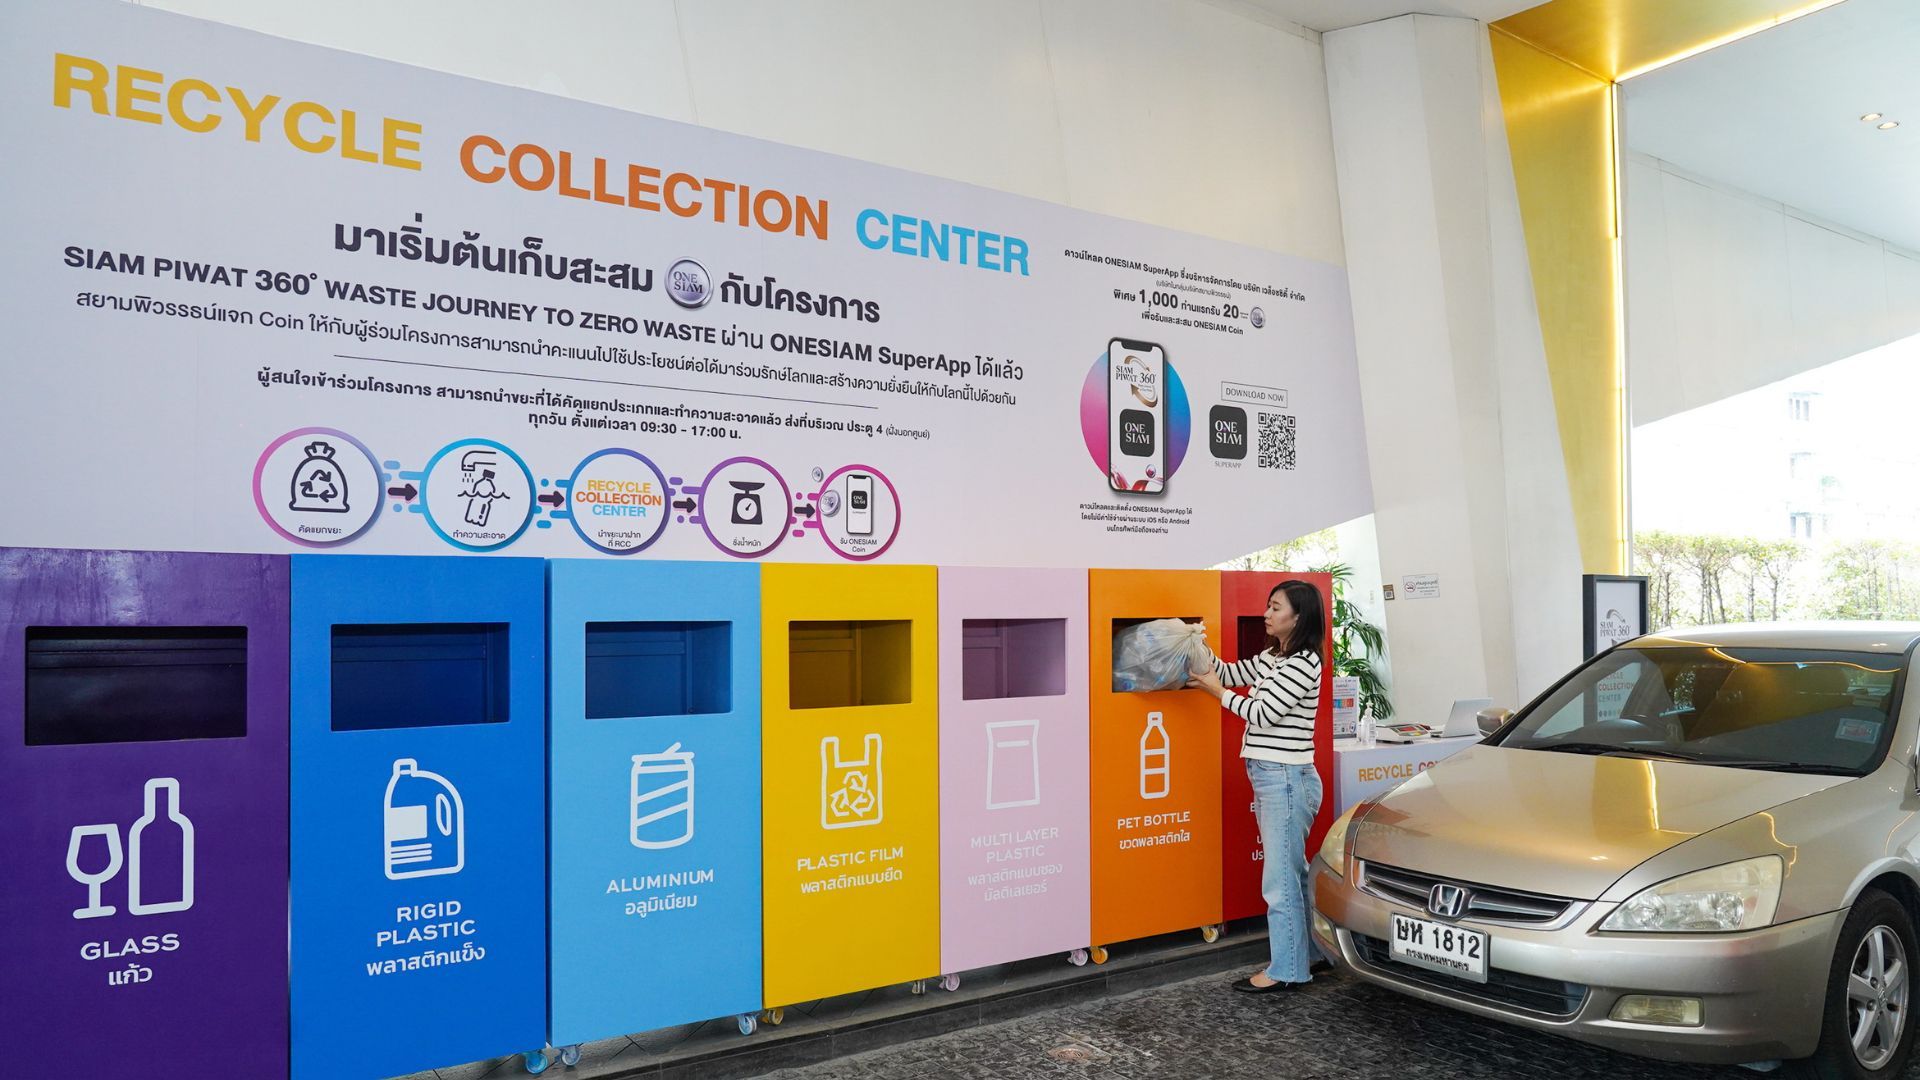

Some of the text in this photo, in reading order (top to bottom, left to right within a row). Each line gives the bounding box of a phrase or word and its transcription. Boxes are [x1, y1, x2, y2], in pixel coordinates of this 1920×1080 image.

[53, 53, 1030, 276] RECYCLE COLLECTION CENTER
[334, 212, 653, 293] มาเริ่มต้นเก็บสะสม
[673, 271, 697, 283] ONE
[1064, 249, 1103, 264] ดาวน์โหลด
[1104, 256, 1142, 270] ONESIAM
[1143, 263, 1179, 279] SuperApp
[1243, 282, 1261, 294] บริษัท
[674, 281, 703, 293] SIAM
[720, 272, 880, 323] กับโครงการ
[64, 246, 145, 275] SIAM
[154, 257, 248, 287] PIWAT
[324, 279, 417, 309] WASTE
[422, 293, 538, 322] JOURNEY
[543, 307, 574, 327] TO
[579, 312, 638, 334] ZERO
[643, 320, 716, 344] WASTE
[721, 323, 763, 349] ผ่าน
[770, 333, 872, 362] ONESIAM
[878, 346, 971, 377] SuperApp
[975, 355, 1024, 380] ได้แล้ว
[76, 291, 253, 324] สยามพิวรรธน์แจก
[259, 311, 304, 330] Coin
[1113, 288, 1136, 302] พิเศษ
[1139, 289, 1178, 309] 1,000
[1181, 300, 1220, 316] ท่านแรกรับ
[1223, 303, 1240, 319] 20
[1193, 320, 1227, 332] ONESIAM
[1228, 326, 1244, 335] Coin
[1115, 373, 1138, 383] PIWAT
[1116, 365, 1134, 374] SIAM
[257, 366, 432, 396] ผู้สนใจเข้าร่วมโครงการ
[785, 412, 843, 431] ส่งที่บริเวณ
[847, 422, 873, 437] ประตู
[876, 424, 883, 434] 4
[1225, 387, 1285, 402] DOWNLOAD NOW
[528, 411, 567, 428] ทุกวัน
[571, 409, 636, 431] ตั้งแต่เวลา
[640, 421, 677, 434] 09:30
[691, 425, 726, 438] 17:00
[729, 429, 742, 440] น.
[1124, 422, 1146, 434] ONE
[1214, 420, 1238, 433] ONE
[1125, 432, 1150, 445] SIAM
[1215, 431, 1242, 446] SIAM
[587, 479, 651, 493] RECYCLE
[575, 491, 662, 506] COLLECTION
[592, 504, 646, 517] CENTER
[1132, 505, 1159, 513] ONESIAM
[1159, 507, 1186, 516] SuperApp
[298, 524, 342, 534] คัดแยกขยะ
[452, 530, 506, 540] ทำความสะอาด
[615, 540, 631, 548] RCC
[1358, 763, 1413, 782] RECYCLE
[1117, 811, 1190, 830] PET BOTTLE
[971, 827, 1059, 848] MULTI LAYER
[1119, 829, 1190, 850] ขวดพลาสติกใส
[797, 845, 904, 872] PLASTIC FILM
[986, 845, 1046, 863] PLASTIC
[606, 868, 714, 894] ALUMINIUM
[800, 868, 903, 894] พลาสติกแบบยืด
[968, 863, 1063, 886] พลาสติกแบบซอง
[984, 879, 1048, 901] มัลติเลเยอร์
[396, 900, 462, 923] RIGID
[624, 894, 697, 918] อลูมิเนียม
[376, 919, 476, 948] PLASTIC
[1432, 926, 1480, 959] 1812
[80, 932, 180, 961] GLASS
[366, 942, 486, 976] พลาสติกแข็ง
[107, 963, 153, 985] แก้ว
